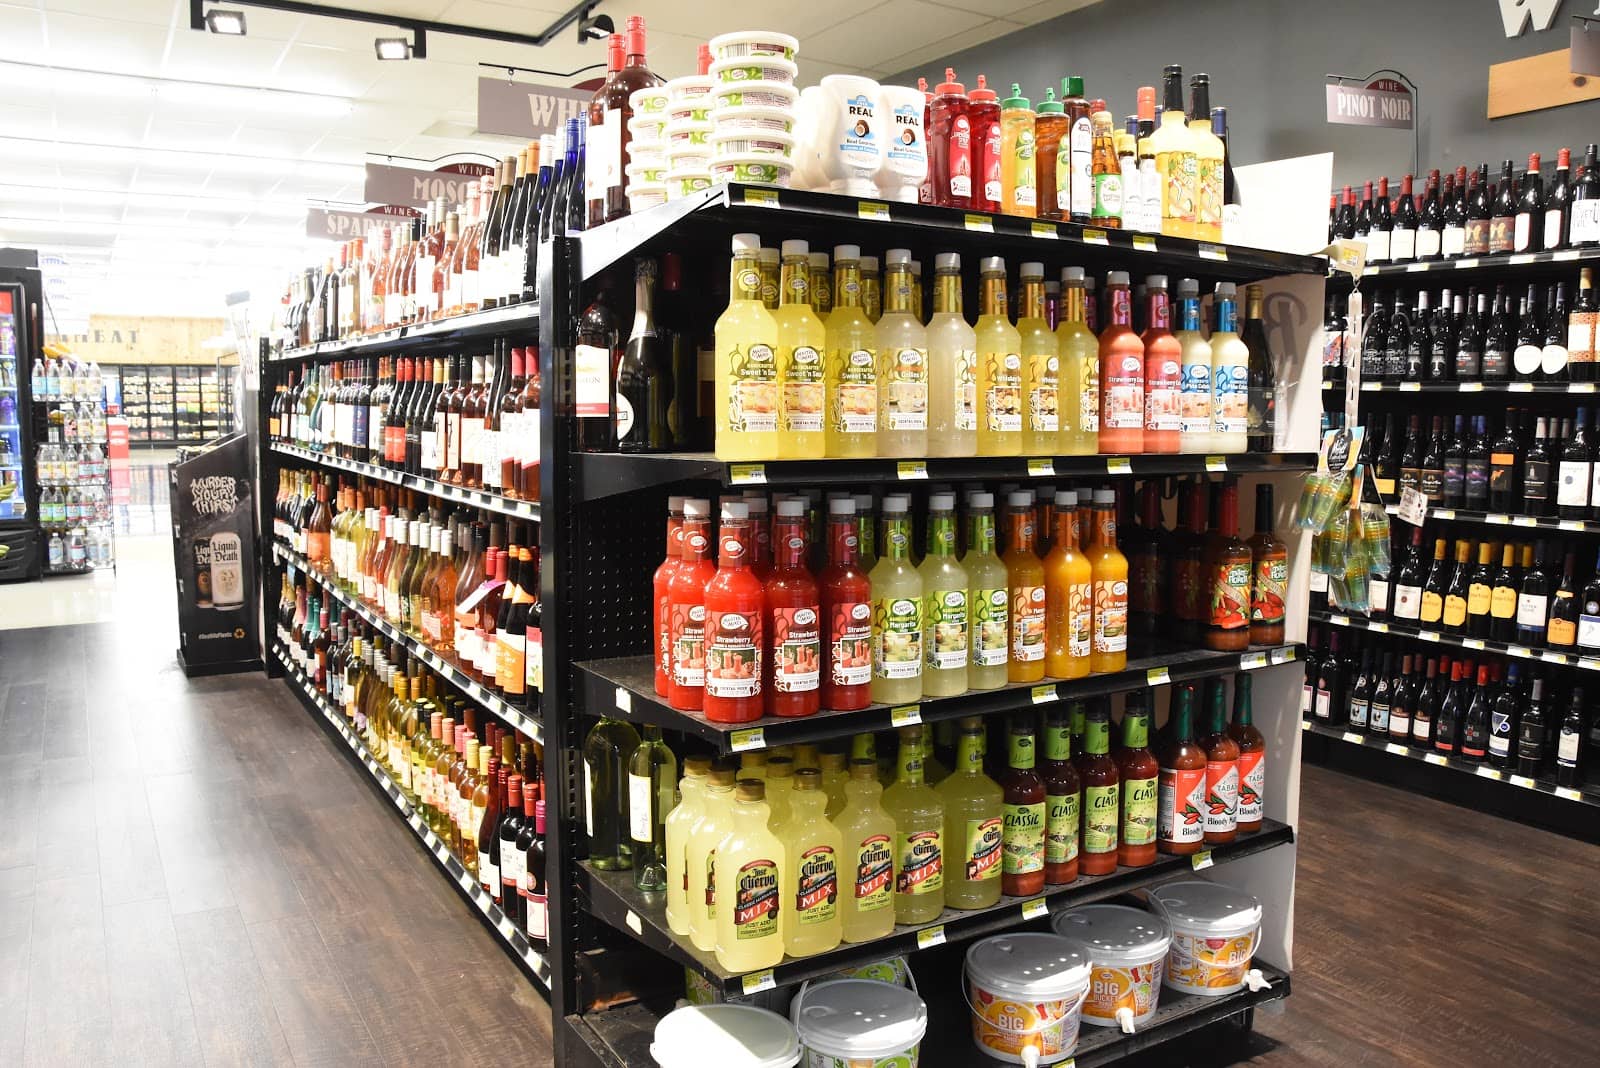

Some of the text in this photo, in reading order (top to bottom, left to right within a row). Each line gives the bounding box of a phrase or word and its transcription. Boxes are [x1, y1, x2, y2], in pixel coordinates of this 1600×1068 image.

[1378, 80, 1399, 92] WINE
[849, 106, 873, 117] REAL
[1337, 92, 1411, 121] PINOT NOIR
[896, 115, 919, 126] REAL
[458, 163, 491, 176] WINE
[384, 206, 412, 217] WINE
[212, 541, 238, 552] Liquid
[214, 551, 238, 562] Death
[889, 621, 917, 630] Margarita
[716, 636, 751, 644] Strawberry
[860, 849, 890, 864] Cuervo
[802, 860, 834, 876] Cuervo
[907, 862, 938, 883] MIX
[740, 874, 775, 890] Cuervo
[861, 871, 889, 894] MIX
[801, 883, 832, 907] MIX
[740, 897, 774, 921] MIX
[1093, 982, 1119, 996] BIG
[999, 1014, 1025, 1030] BIG
